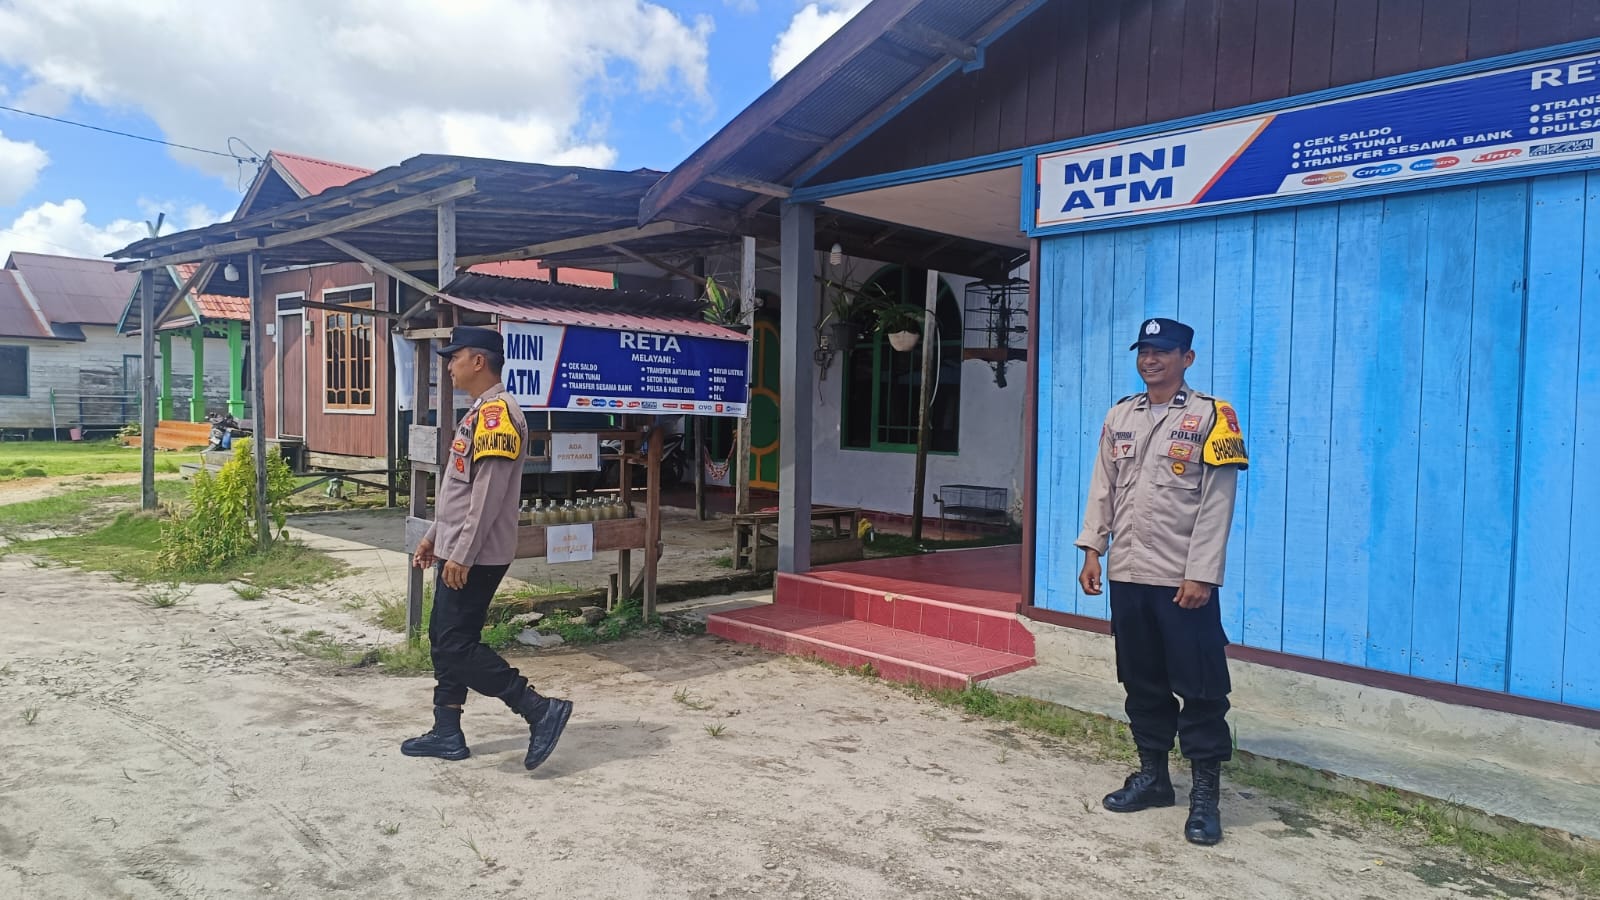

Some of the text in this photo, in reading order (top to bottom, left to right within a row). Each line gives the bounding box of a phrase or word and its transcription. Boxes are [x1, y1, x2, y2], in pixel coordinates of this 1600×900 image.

[1531, 60, 1600, 90] RE
[1303, 136, 1402, 157] TARIK TUNAI
[1304, 126, 1392, 148] CEK SALDO
[1302, 129, 1513, 168] TRANSFER SESAMA BANK
[1064, 144, 1186, 184] MINI
[1355, 165, 1399, 176] Cirrus
[1060, 176, 1173, 213] ATM
[507, 333, 543, 361] MINI
[620, 331, 682, 352] RETA
[569, 362, 598, 371] CEK SALDO
[569, 372, 601, 381] TARIK TUNAI
[646, 366, 671, 374] TRANSFER
[506, 369, 540, 395] ATM
[569, 381, 633, 392] TRANSFER SESAMA BANK
[664, 376, 678, 384] TUNAI
[1170, 430, 1202, 442] POLRI
